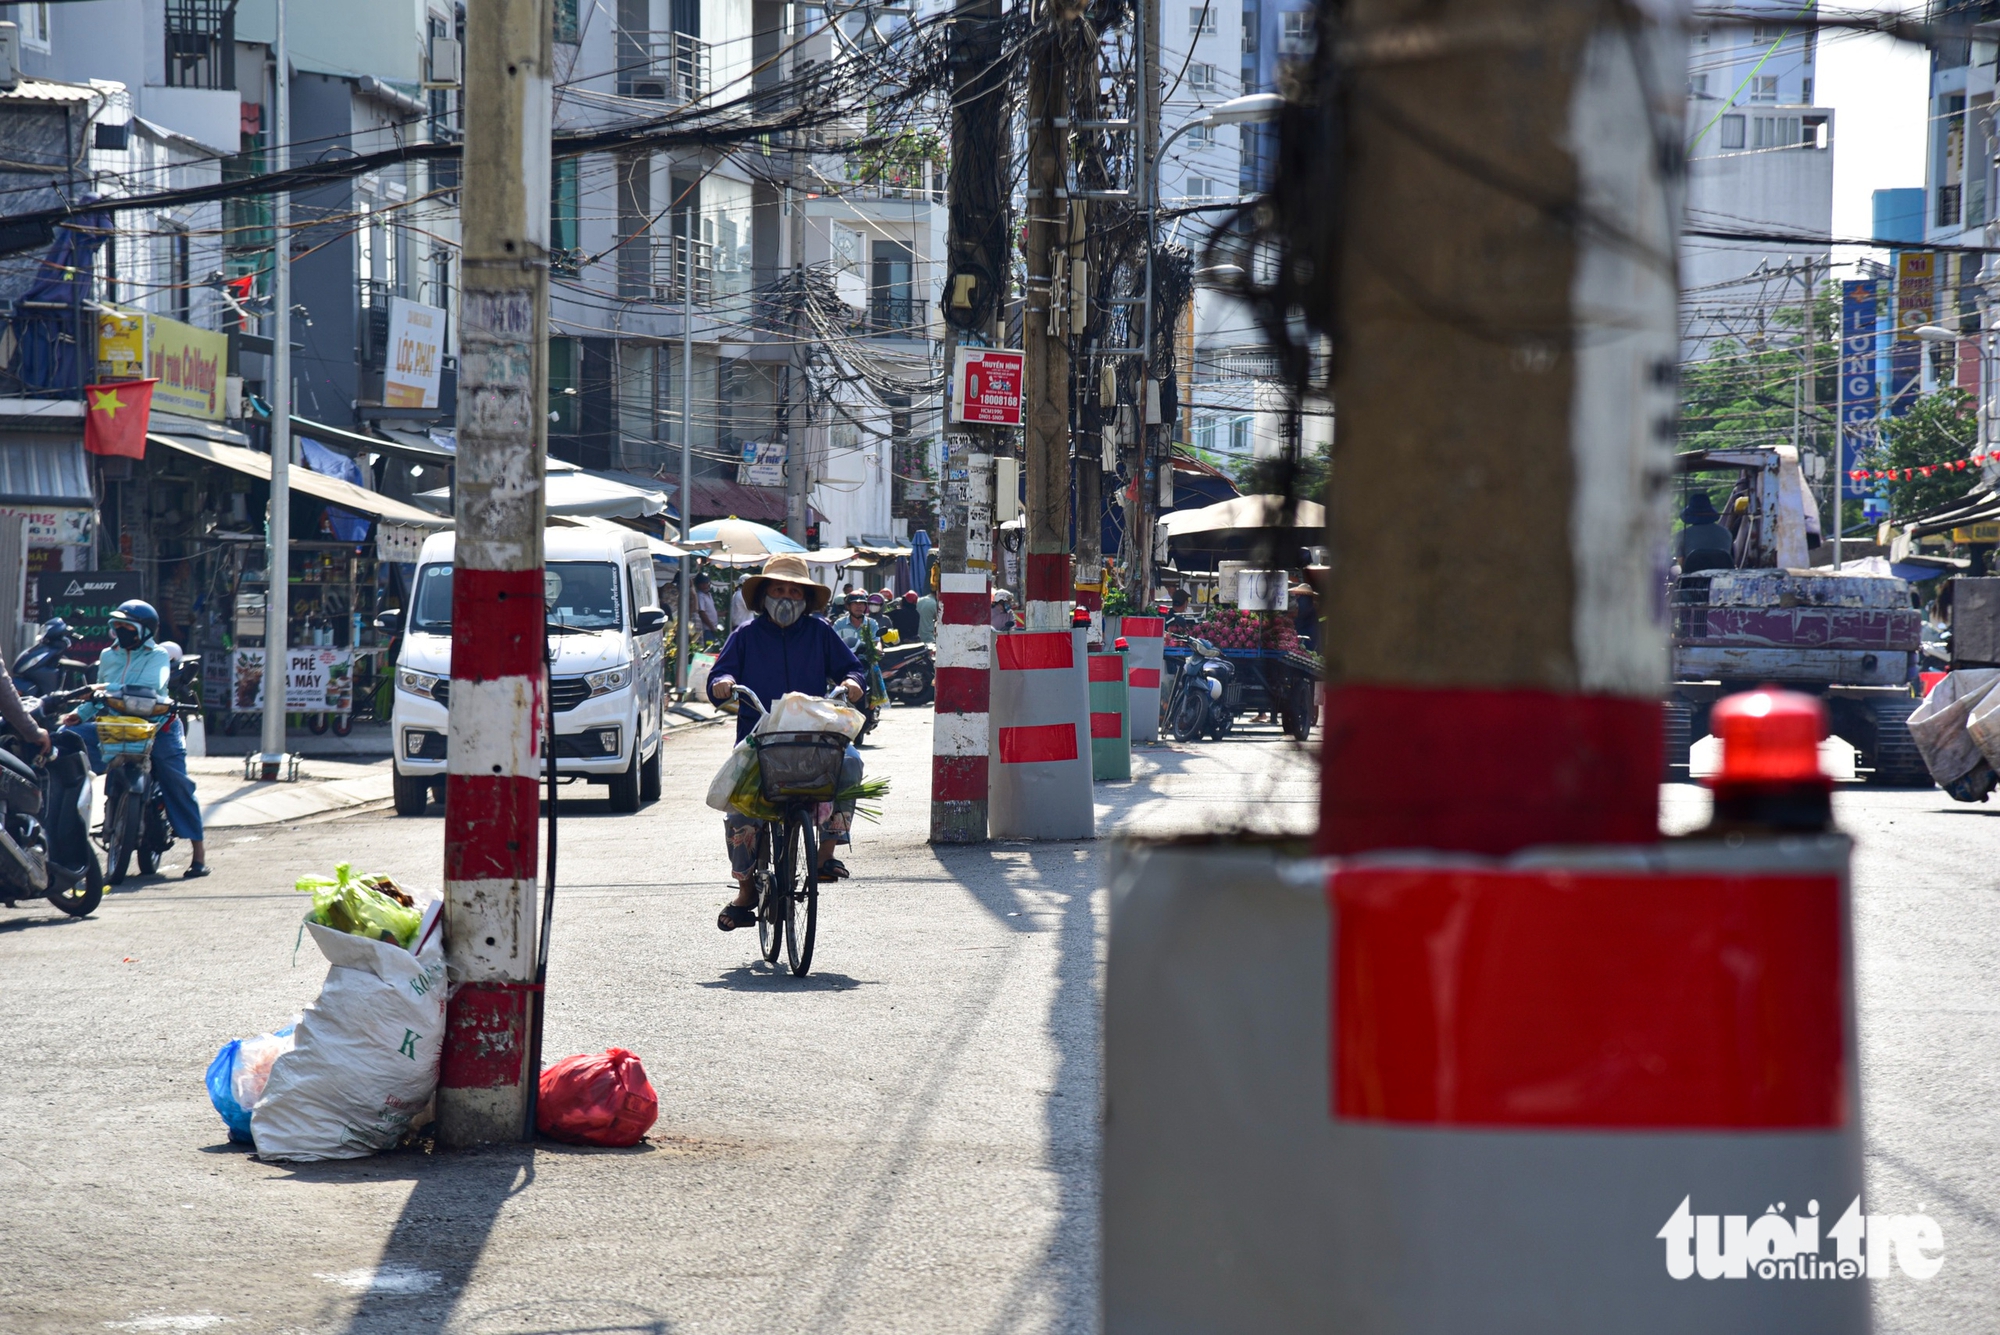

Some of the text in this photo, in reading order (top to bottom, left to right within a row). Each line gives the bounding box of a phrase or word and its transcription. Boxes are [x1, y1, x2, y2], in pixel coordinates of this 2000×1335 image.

[1849, 311, 1870, 396] LONG
[980, 394, 1018, 407] 18008168
[83, 581, 118, 590] BEAUTY
[292, 654, 316, 671] PHÊ
[295, 671, 323, 688] MÁY
[398, 1027, 423, 1062] K
